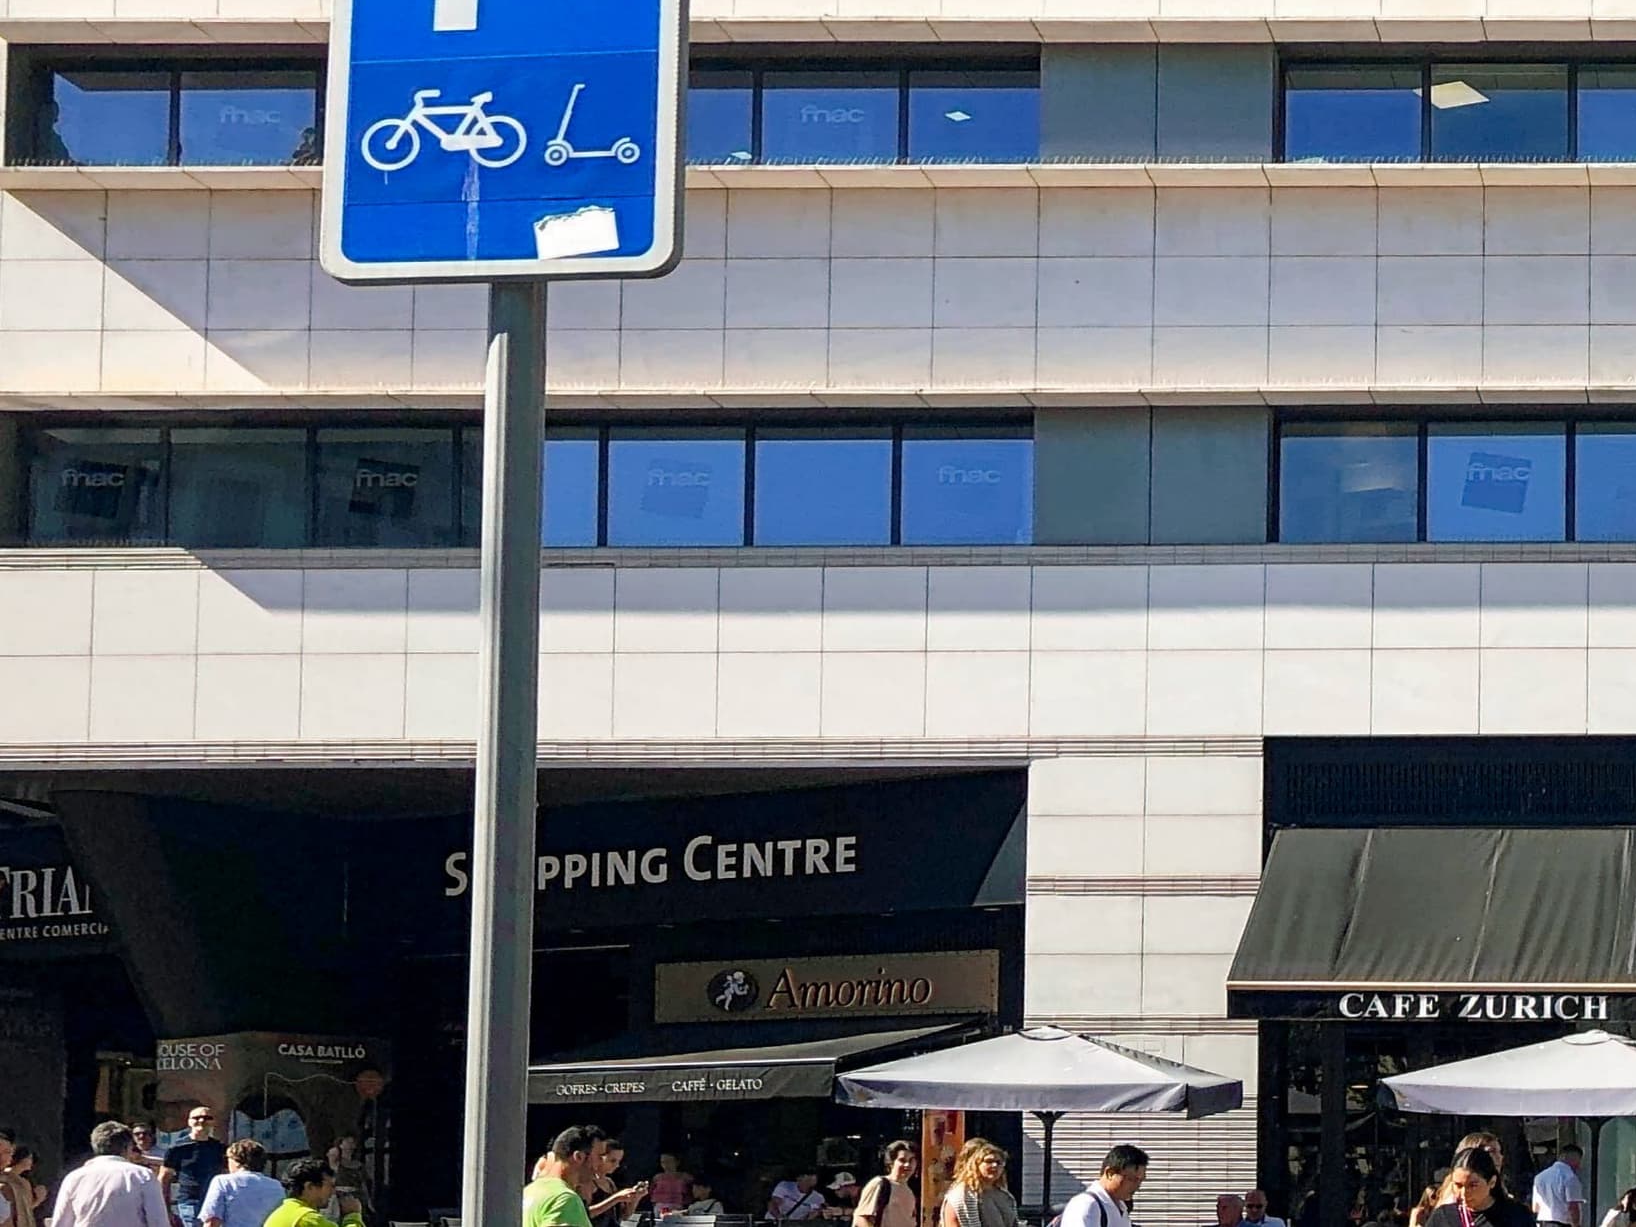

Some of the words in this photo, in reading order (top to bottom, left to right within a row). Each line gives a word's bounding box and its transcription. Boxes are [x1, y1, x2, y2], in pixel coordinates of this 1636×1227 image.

[800, 105, 865, 123] fnac
[356, 468, 419, 487] fnac
[1468, 463, 1530, 481] fnac
[445, 847, 668, 897] SPPING
[764, 967, 934, 1011] Amorino
[1339, 993, 1440, 1018] CAFE
[1458, 993, 1609, 1019] ZURICH
[200, 1043, 225, 1057] OF
[278, 1043, 314, 1057] CASA
[716, 1078, 763, 1091] GELATO
